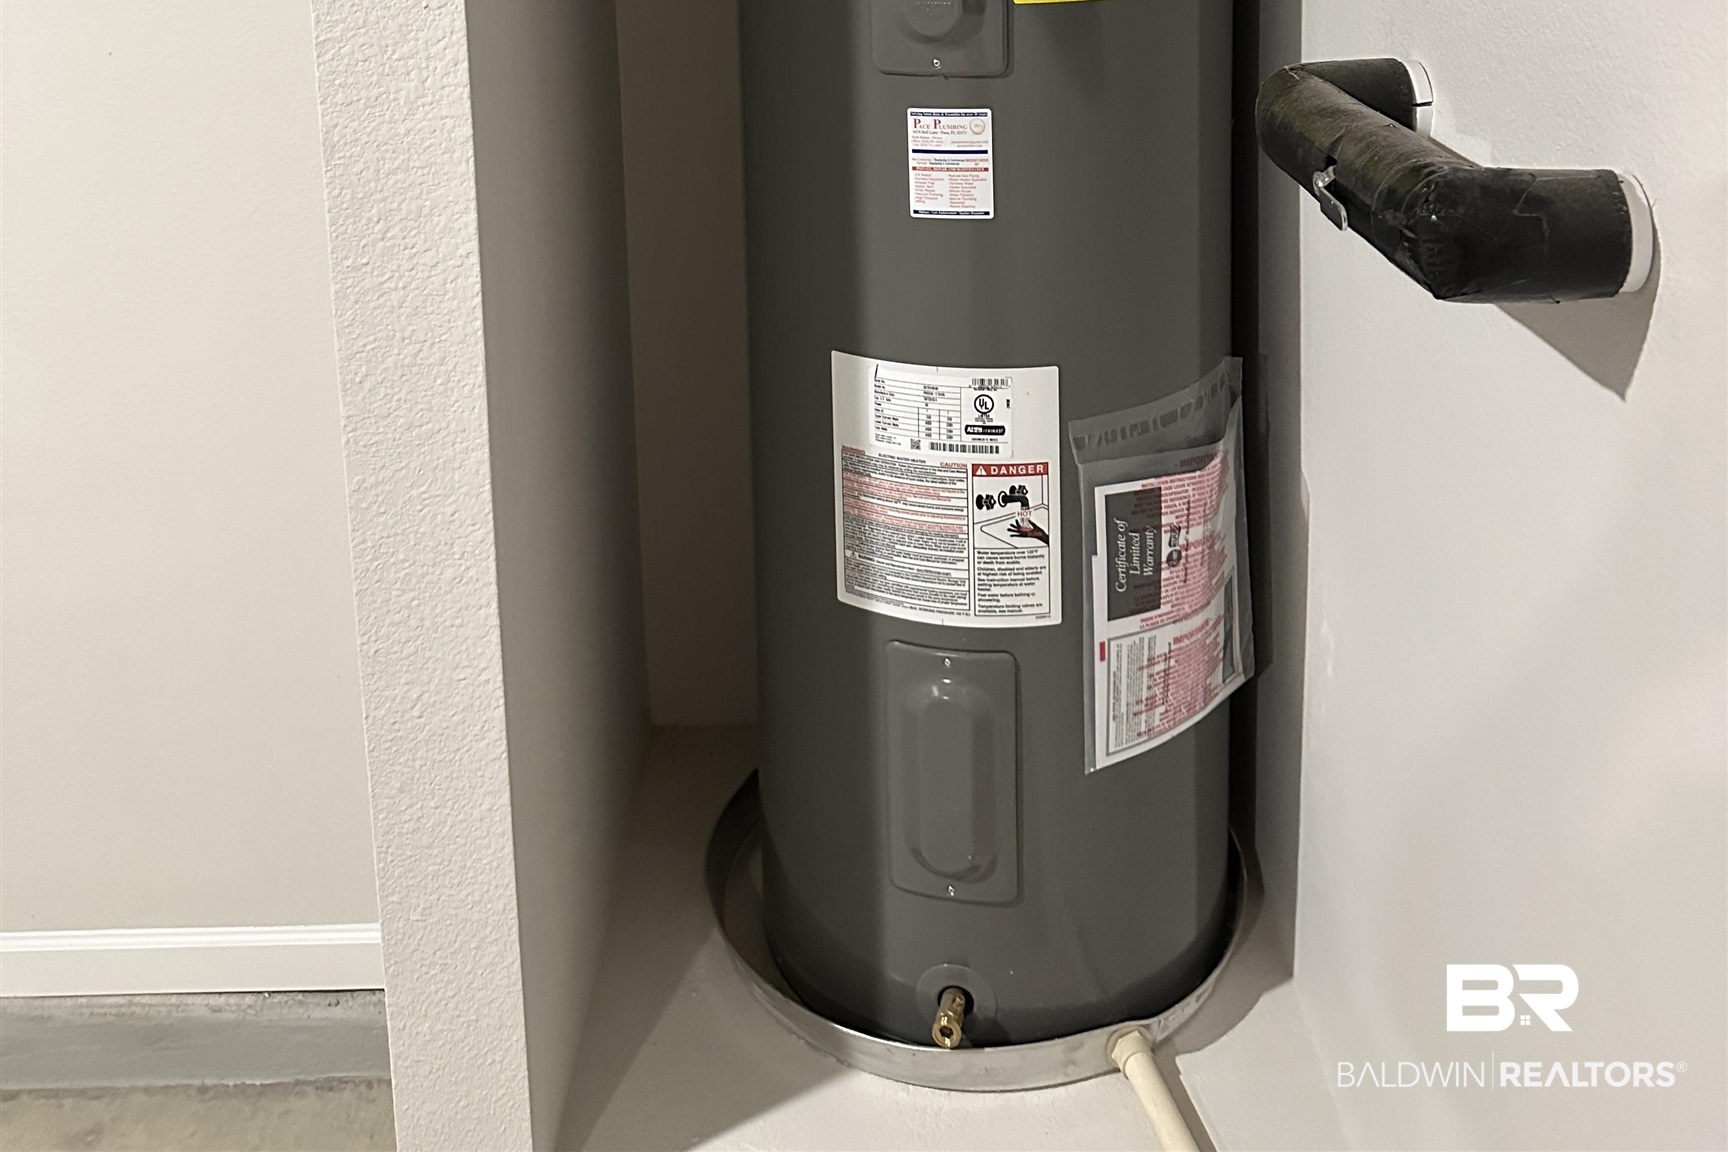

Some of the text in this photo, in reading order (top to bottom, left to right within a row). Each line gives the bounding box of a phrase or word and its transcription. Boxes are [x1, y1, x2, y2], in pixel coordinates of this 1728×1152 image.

[913, 118, 968, 130] PACE PLUMBING
[979, 398, 989, 409] UL
[990, 464, 1044, 475] DANGER
[1114, 518, 1129, 592] Certificate of
[1129, 532, 1140, 575] Limited
[1143, 525, 1156, 576] Warranty
